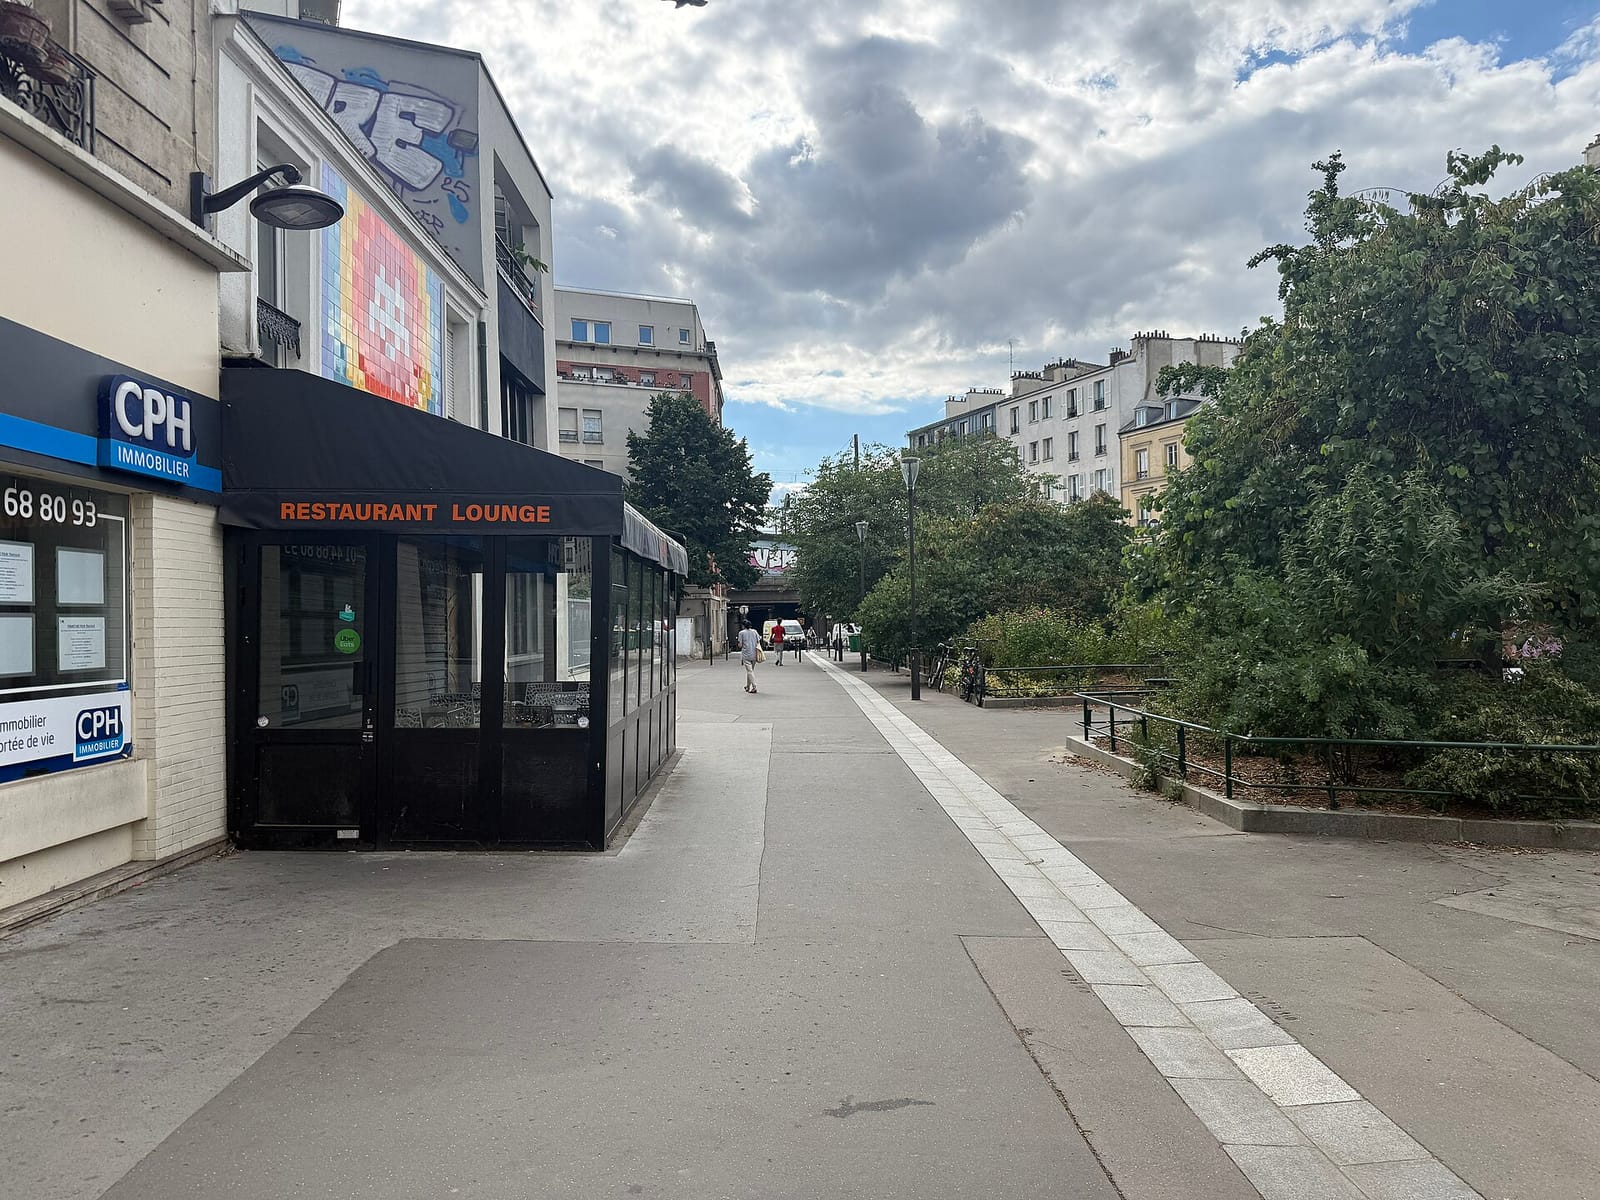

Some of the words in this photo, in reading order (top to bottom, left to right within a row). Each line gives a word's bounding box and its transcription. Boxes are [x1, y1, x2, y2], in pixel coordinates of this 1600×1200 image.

[114, 381, 191, 451] CPH
[118, 446, 190, 478] IMMOBILIER
[4, 488, 33, 518] 68
[39, 493, 66, 523] 80
[72, 499, 97, 528] 93
[281, 503, 437, 521] RESTAURANT
[452, 505, 550, 522] LOUNGE
[340, 634, 356, 642] Uber
[77, 709, 119, 740] CPH
[26, 735, 39, 748] de
[40, 732, 55, 746] vie
[79, 740, 119, 754] IMMOBILIER
